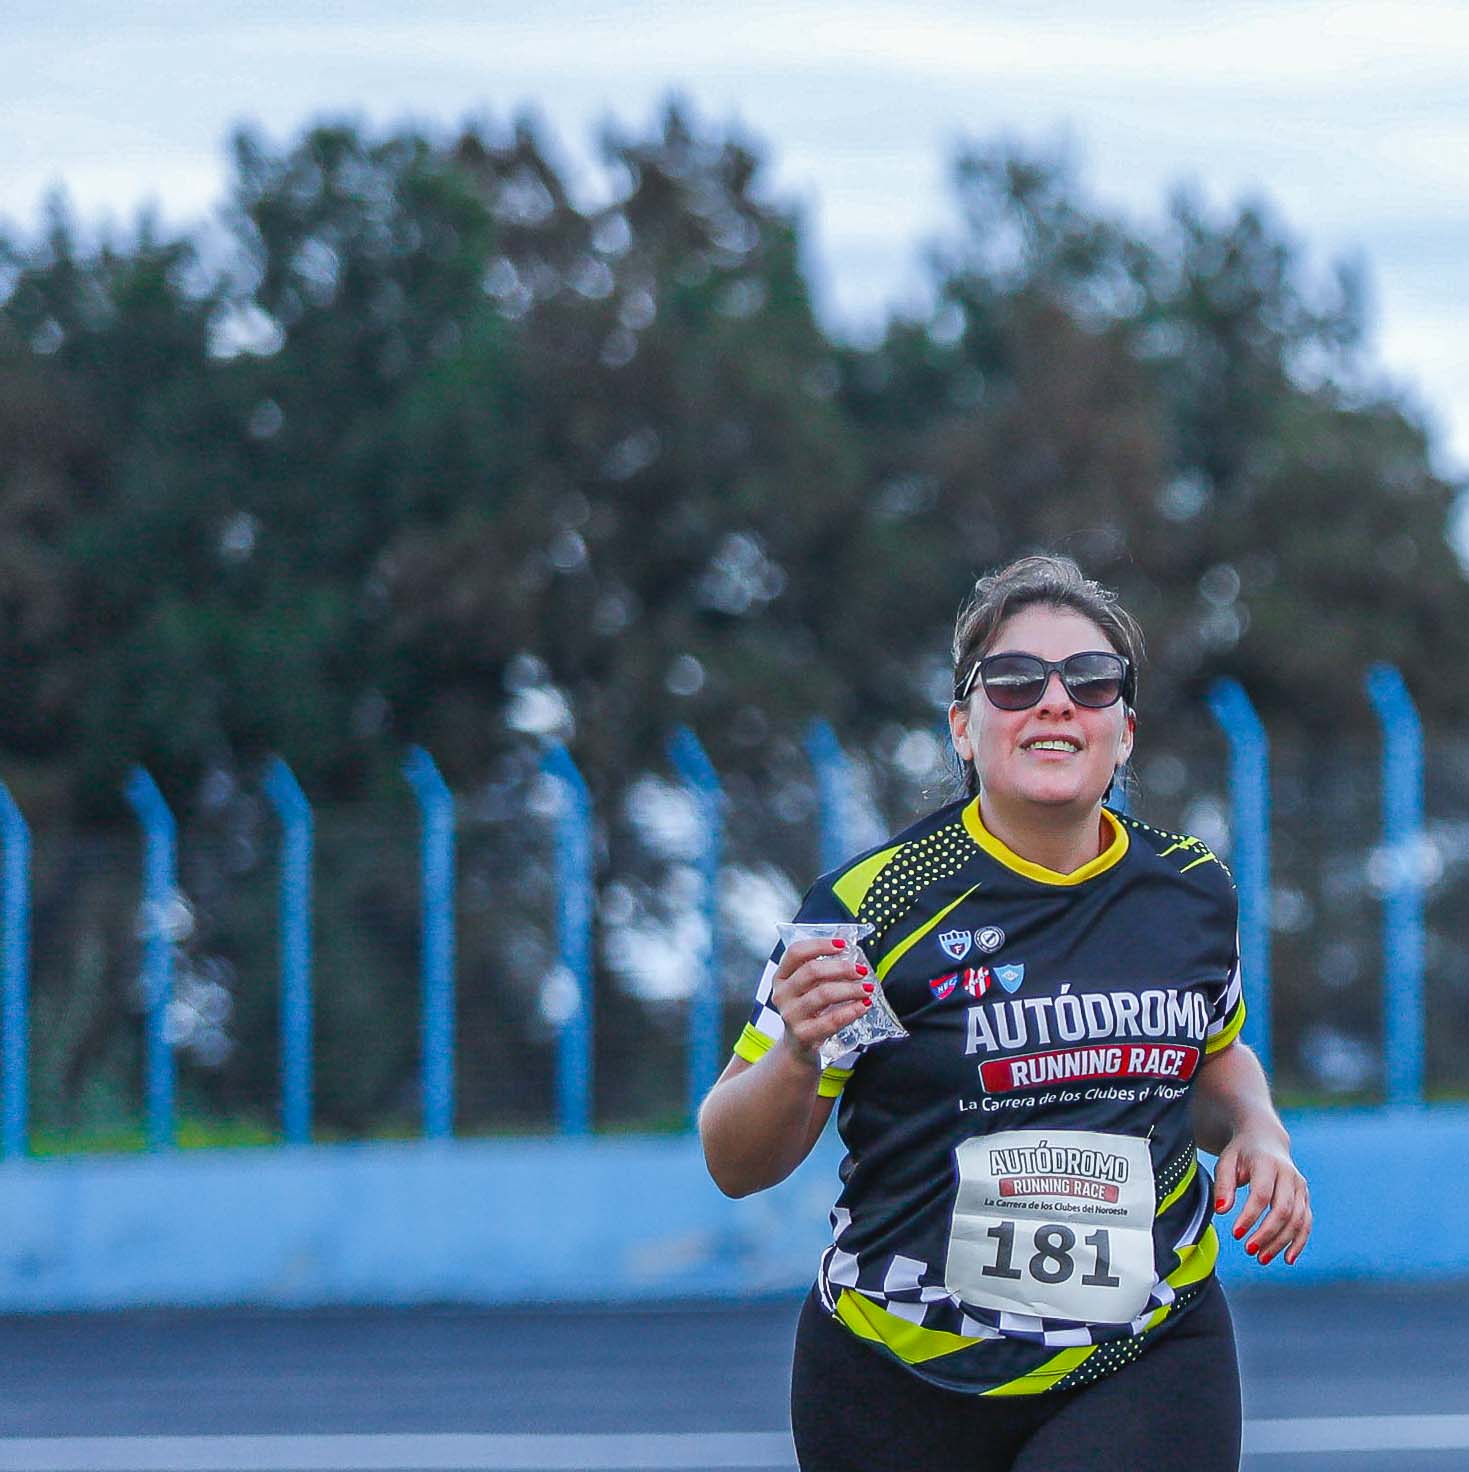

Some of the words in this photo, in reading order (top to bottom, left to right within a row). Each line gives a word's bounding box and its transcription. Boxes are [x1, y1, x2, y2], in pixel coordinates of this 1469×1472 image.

[964, 984, 1209, 1055] AUTÓDROMO
[1010, 1050, 1123, 1088] RUNNING
[1127, 1048, 1187, 1077] RACE
[959, 1099, 978, 1112] La
[982, 1097, 1036, 1112] Carrera
[1039, 1092, 1057, 1105] de
[1059, 1090, 1082, 1102] los
[1084, 1087, 1135, 1101] Clubes
[989, 1140, 1129, 1184] AUTÓDROMO
[984, 1198, 995, 1206] La
[996, 1199, 1027, 1209] Carrera
[1028, 1201, 1040, 1210] de
[1041, 1201, 1053, 1210] los
[1054, 1202, 1081, 1212] Clubes
[1082, 1203, 1094, 1214] del
[1095, 1204, 1128, 1216] Noroeste
[1012, 1178, 1070, 1195] RUNNING
[1073, 1181, 1107, 1200] RACE
[981, 1221, 1120, 1288] 181
